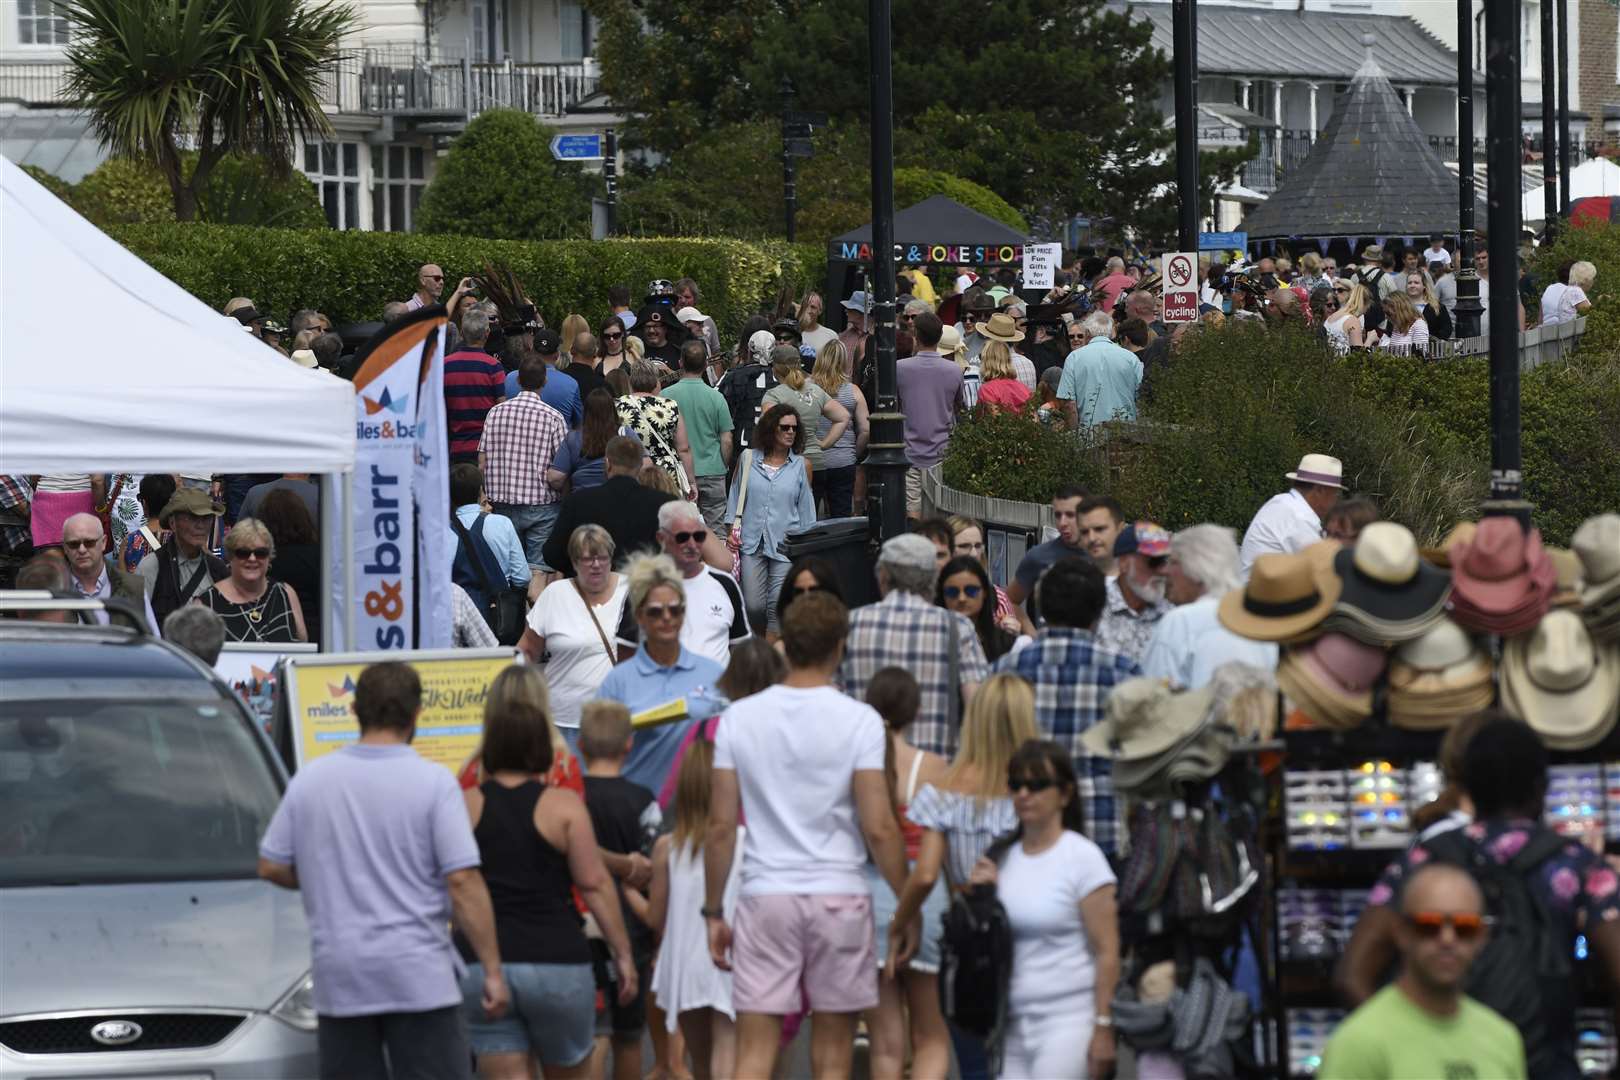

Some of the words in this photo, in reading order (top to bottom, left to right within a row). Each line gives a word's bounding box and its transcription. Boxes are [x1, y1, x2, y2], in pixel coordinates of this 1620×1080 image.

[841, 242, 903, 261] MAC
[907, 245, 922, 262] &
[927, 246, 971, 263] JOKE
[976, 246, 1024, 262] SHOP
[1174, 294, 1187, 304] No
[1165, 307, 1196, 319] cycling
[364, 464, 405, 650] s&barr
[307, 701, 356, 719] miles
